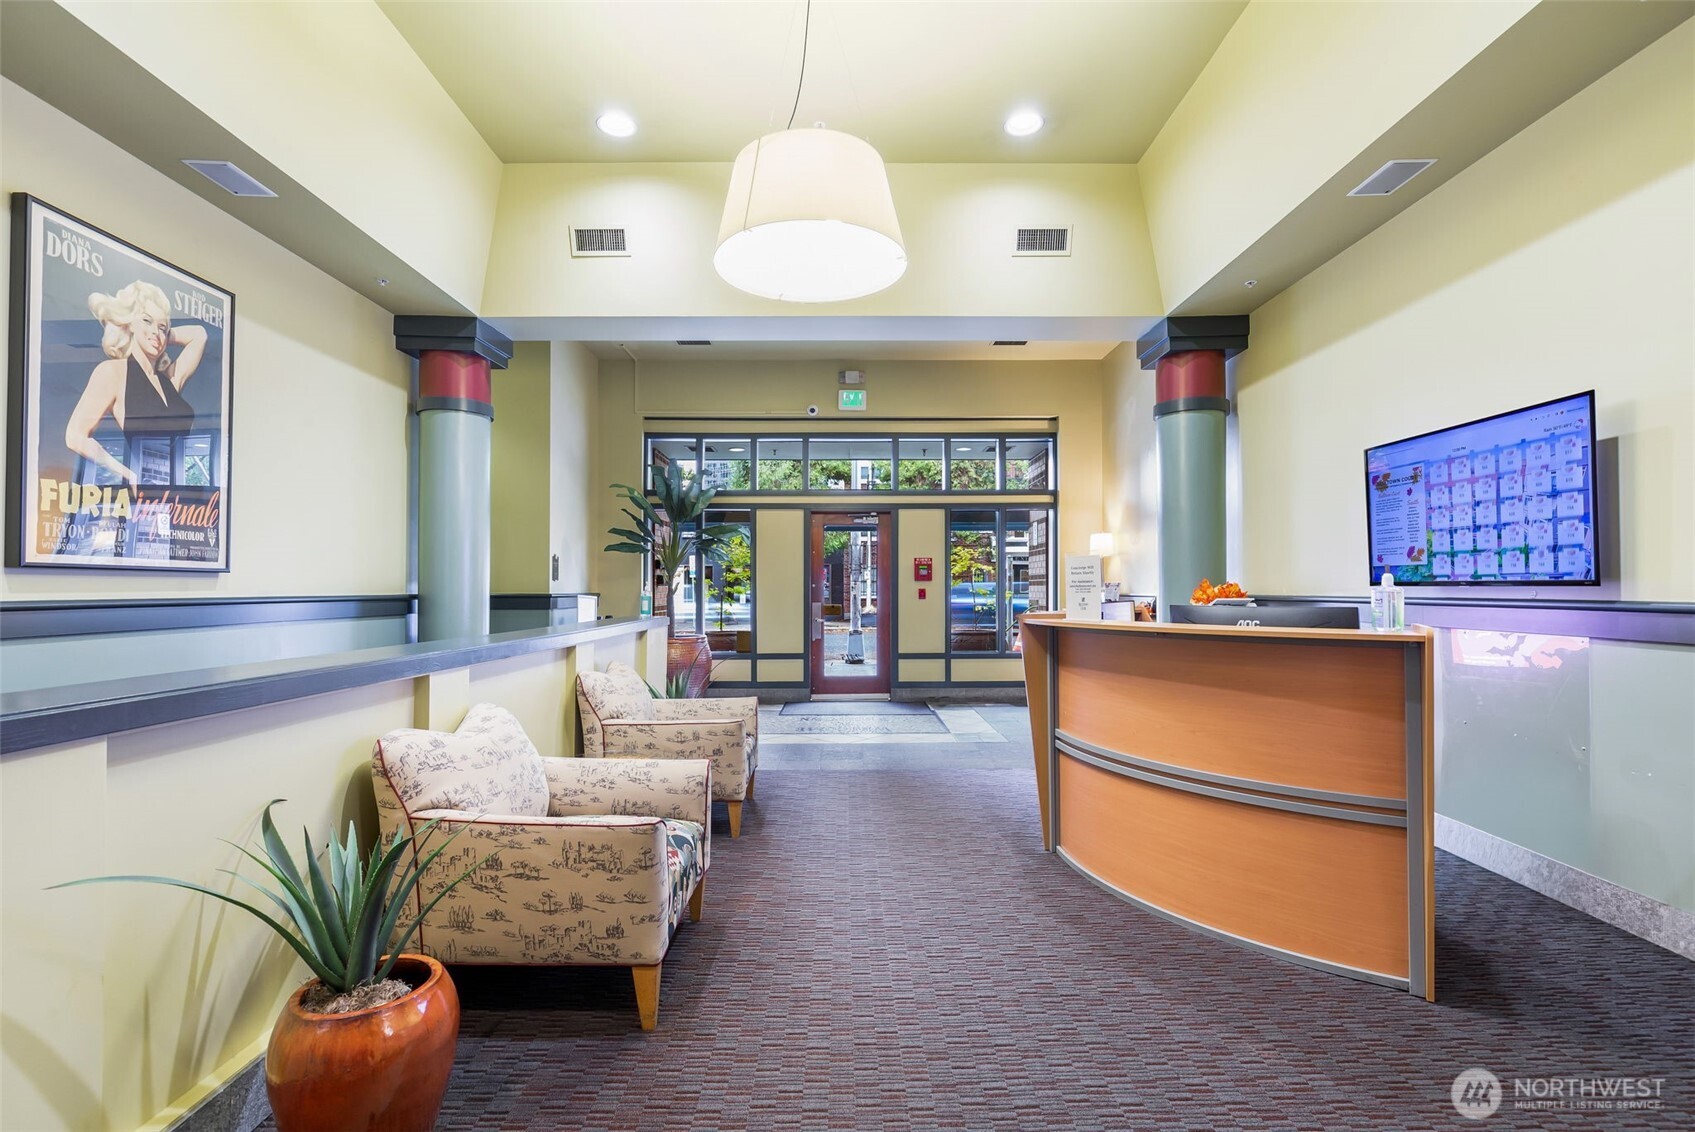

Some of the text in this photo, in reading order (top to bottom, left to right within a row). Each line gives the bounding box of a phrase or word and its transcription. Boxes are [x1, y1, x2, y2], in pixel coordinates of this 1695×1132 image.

[46, 231, 104, 277] DORS
[62, 229, 91, 250] DIANA
[174, 290, 223, 329] STEIGER
[40, 478, 132, 520] FURIA
[131, 490, 219, 542] infernale
[52, 516, 70, 524] TOM
[42, 521, 85, 538] TRYON
